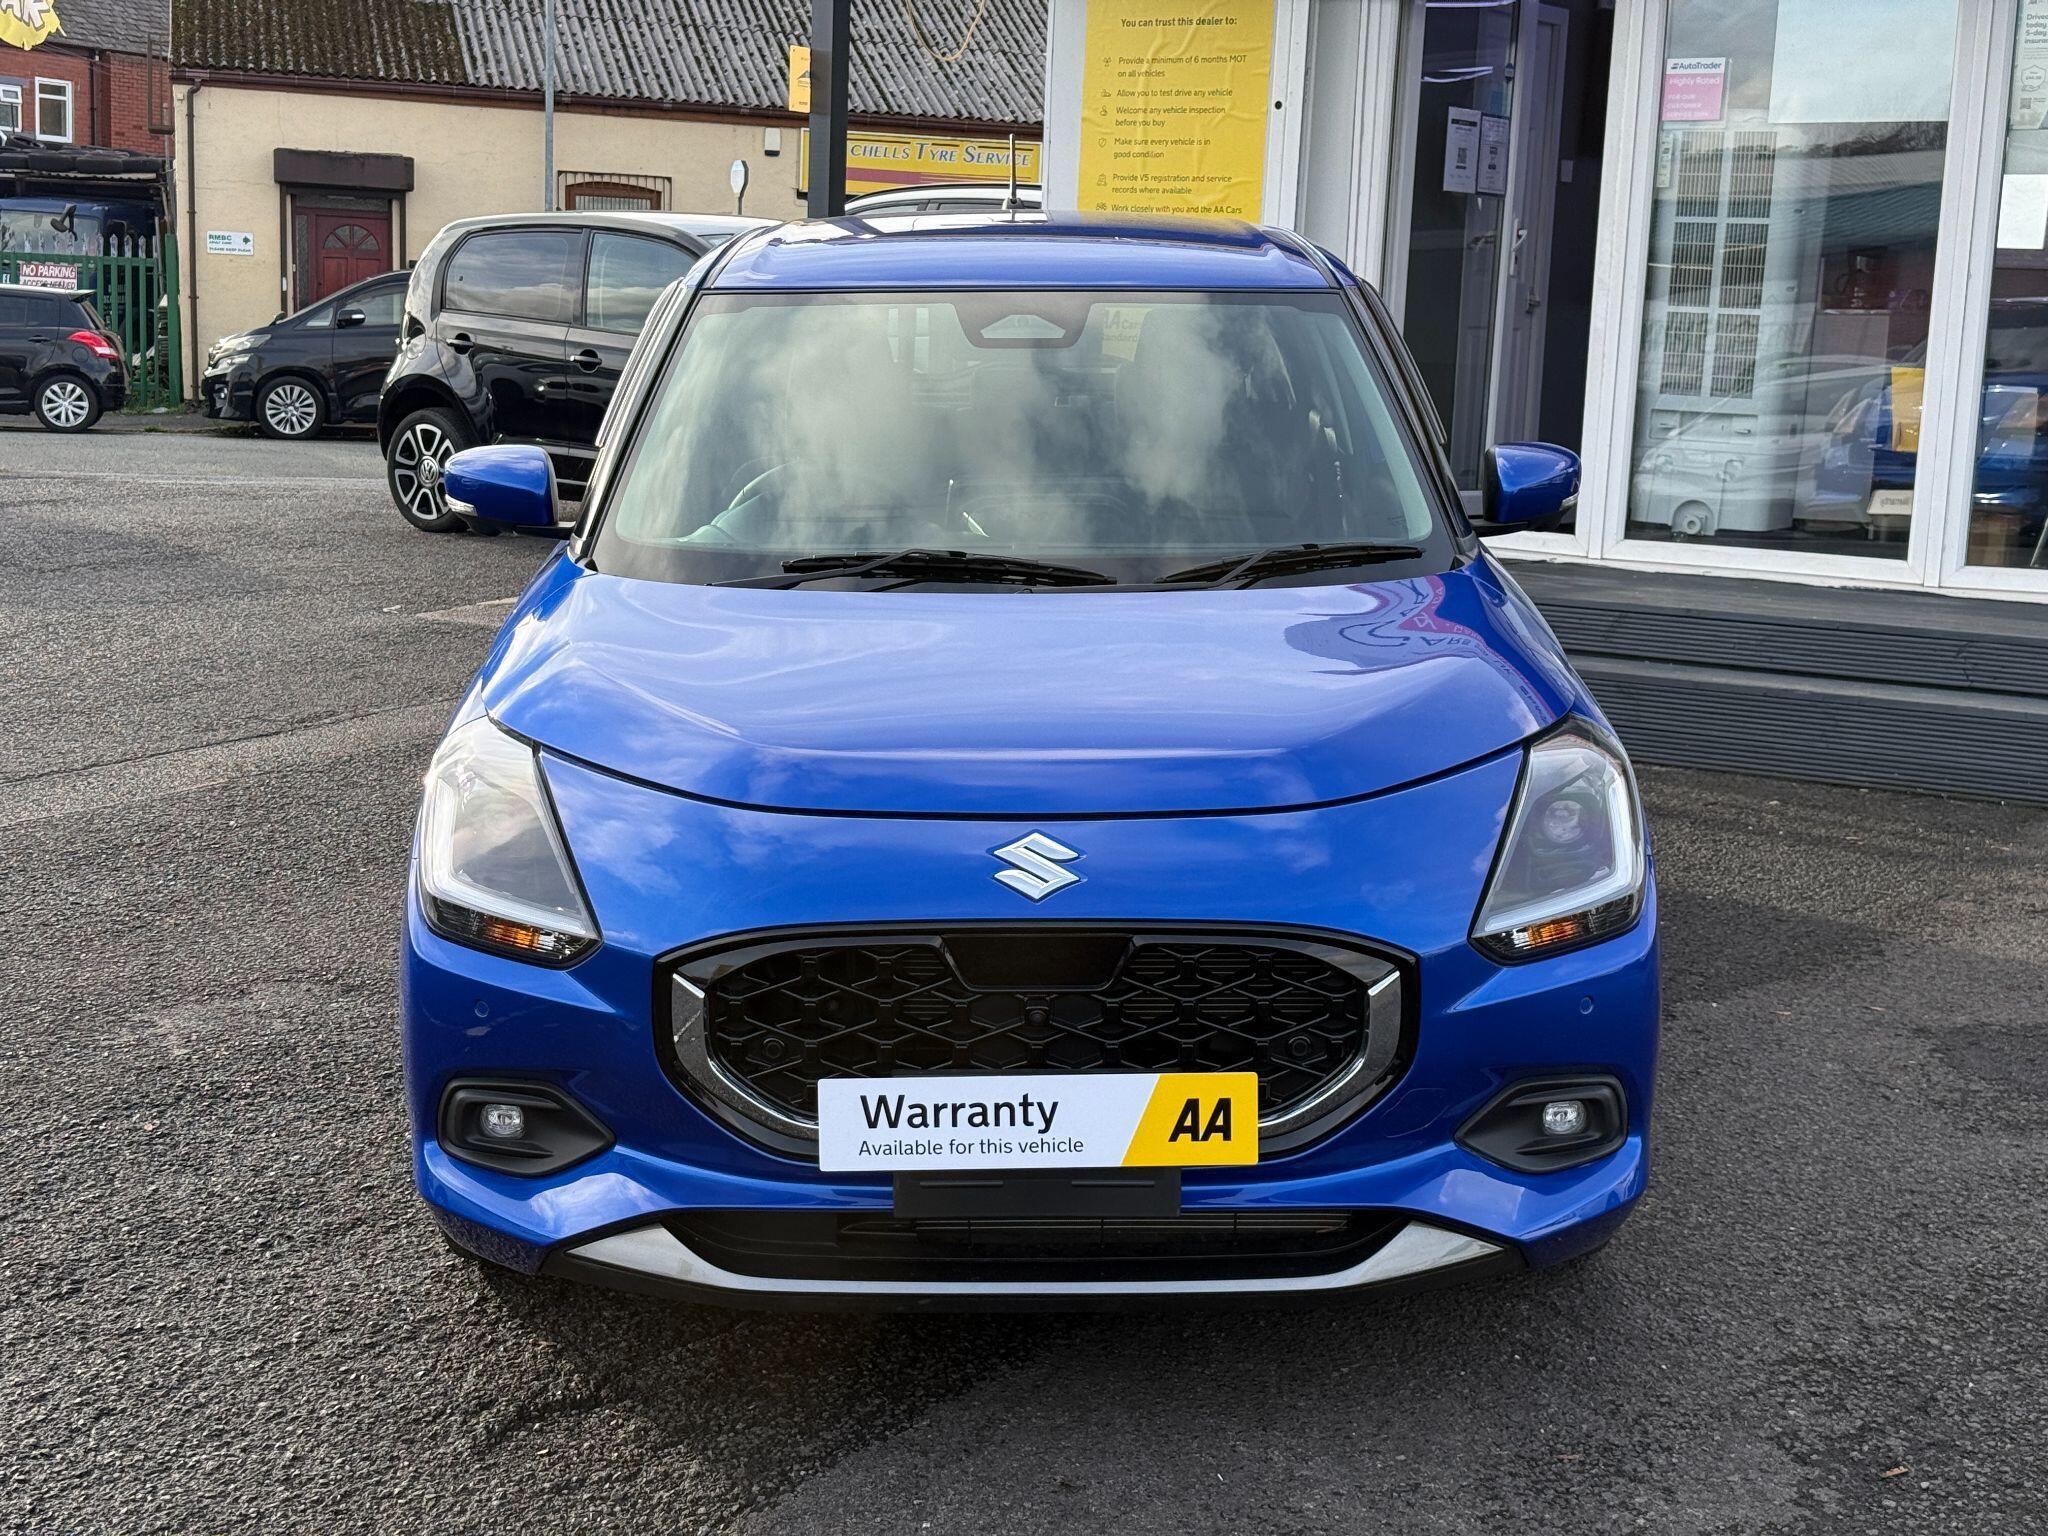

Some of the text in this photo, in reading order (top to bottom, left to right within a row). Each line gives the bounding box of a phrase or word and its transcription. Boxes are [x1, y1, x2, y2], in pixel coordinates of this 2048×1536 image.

[1121, 18, 1136, 27] You
[1155, 18, 1175, 26] trust
[1177, 17, 1193, 26] this
[1195, 17, 1223, 26] dealer
[1225, 16, 1237, 25] to:
[1118, 56, 1144, 65] Provide
[1151, 56, 1184, 64] minimum
[1185, 55, 1193, 64] of
[1201, 55, 1228, 63] months
[1229, 54, 1247, 63] MOT
[1679, 61, 1722, 70] AutoTrader
[1127, 69, 1136, 77] all
[1137, 69, 1165, 77] vehicles
[1117, 89, 1135, 97] Allow
[1137, 90, 1149, 98] you
[1193, 90, 1206, 98] any
[1207, 88, 1233, 96] vehicle
[1116, 106, 1226, 115] Welcome any vehicle inspection
[1115, 119, 1137, 127] before
[1152, 119, 1166, 127] buy
[1150, 139, 1169, 147] every
[1170, 138, 1195, 146] vehicle
[1113, 151, 1131, 159] good
[1113, 174, 1233, 183] Provide V5 registration and service
[1112, 186, 1192, 194] records where available
[1111, 204, 1242, 214] Work closely with you and the AA Cars
[22, 264, 76, 278] NO PARKING
[859, 1092, 1233, 1142] Warranty AA
[858, 1136, 1084, 1156] Available for this vehicle
